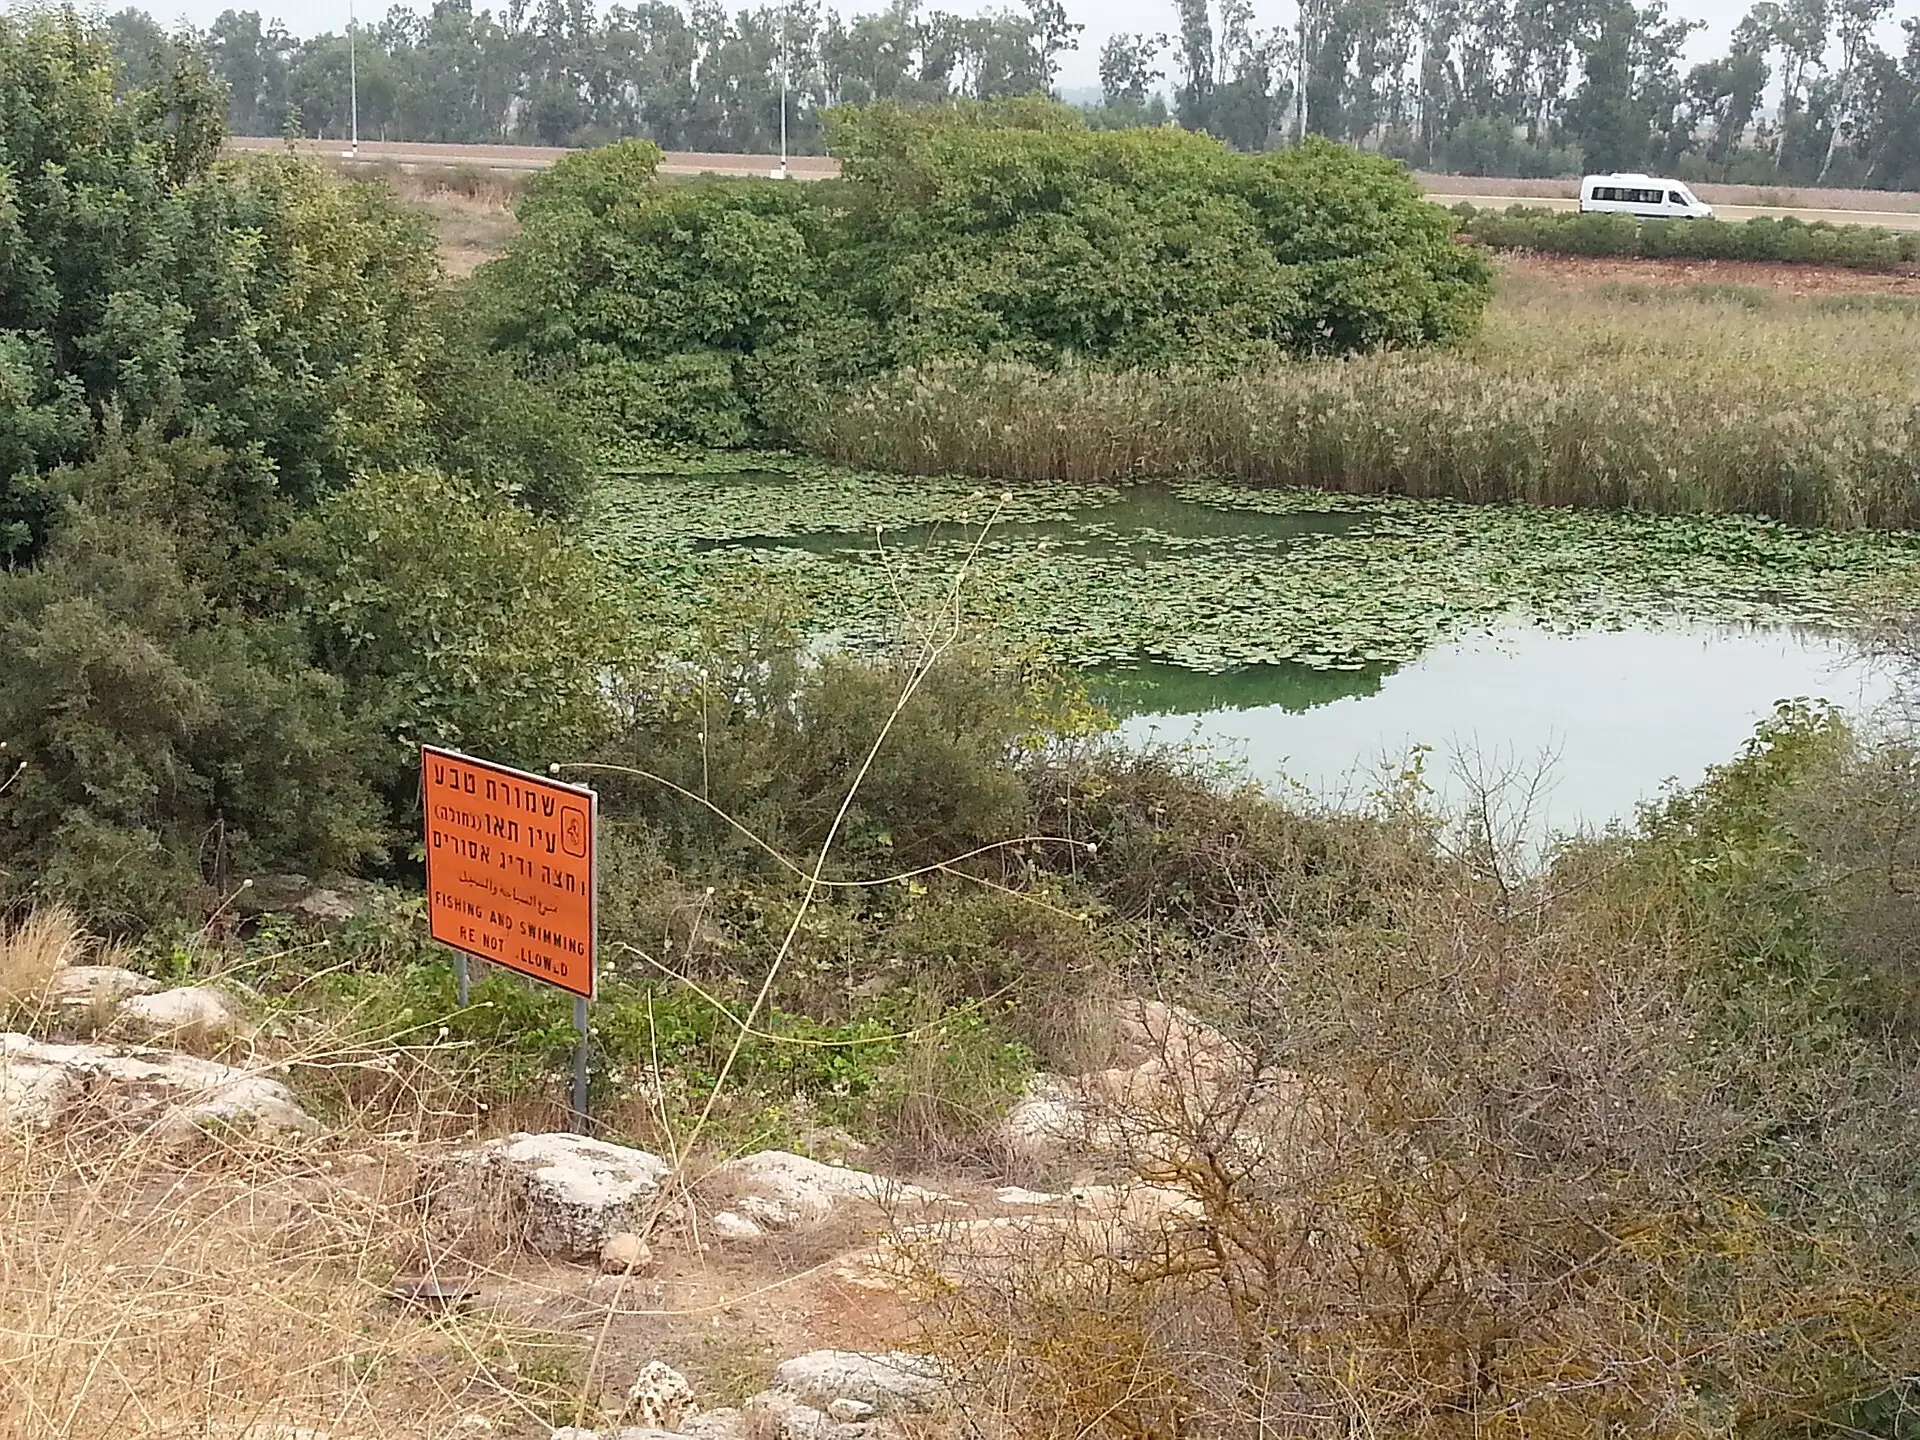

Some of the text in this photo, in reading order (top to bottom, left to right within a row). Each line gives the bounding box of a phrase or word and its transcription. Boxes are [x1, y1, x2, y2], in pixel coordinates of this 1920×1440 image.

[434, 763, 556, 817] שמורת טבע
[432, 830, 490, 863] אסורים
[485, 813, 518, 843] תאו
[435, 890, 585, 956] FISHING AND SWIMMING
[483, 932, 504, 953] NOT
[515, 947, 568, 977] LLOWD
